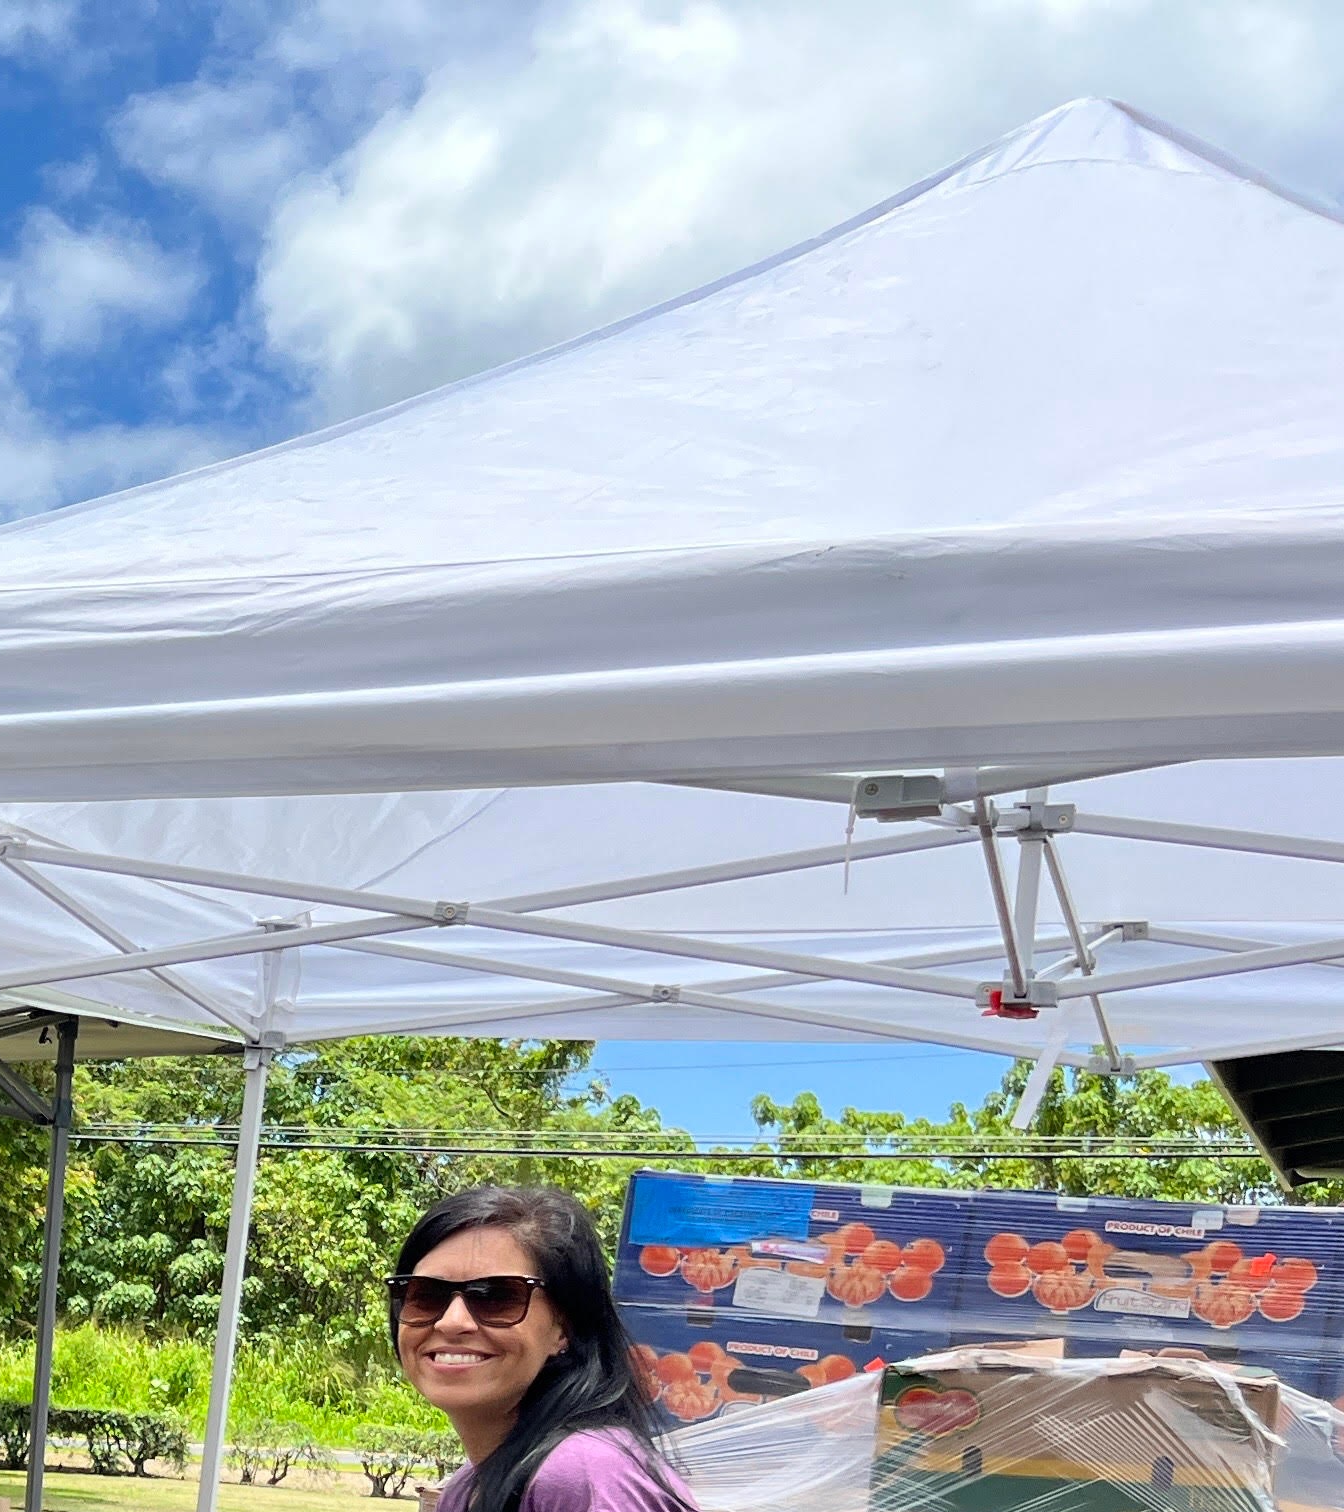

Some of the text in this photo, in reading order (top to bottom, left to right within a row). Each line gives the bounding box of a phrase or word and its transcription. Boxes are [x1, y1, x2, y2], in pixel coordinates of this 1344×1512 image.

[1108, 1221, 1203, 1237] PRODUCT OF CHILE
[728, 1343, 817, 1359] PRODUCT OF CHILE
